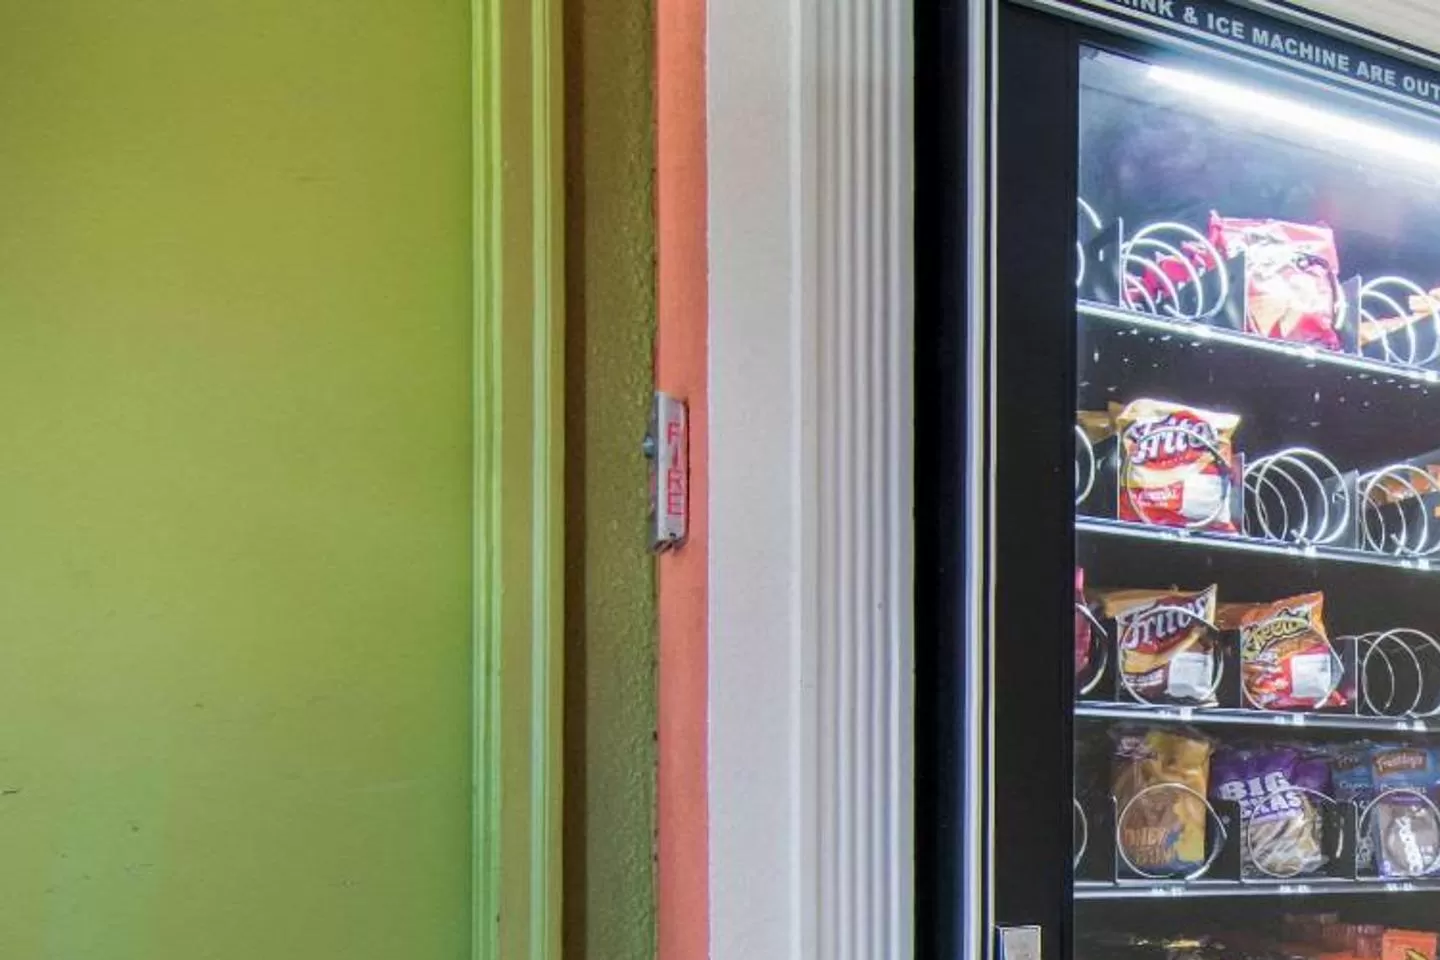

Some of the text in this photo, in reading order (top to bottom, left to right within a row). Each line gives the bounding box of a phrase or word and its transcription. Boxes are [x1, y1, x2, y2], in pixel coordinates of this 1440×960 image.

[1182, 7, 1199, 25] &
[1206, 13, 1245, 39] ICE
[1252, 27, 1349, 72] MACHINE
[1356, 61, 1397, 87] ARE
[667, 421, 684, 516] FIRE
[1219, 771, 1290, 801] BIG
[1239, 790, 1302, 820] EXAS
